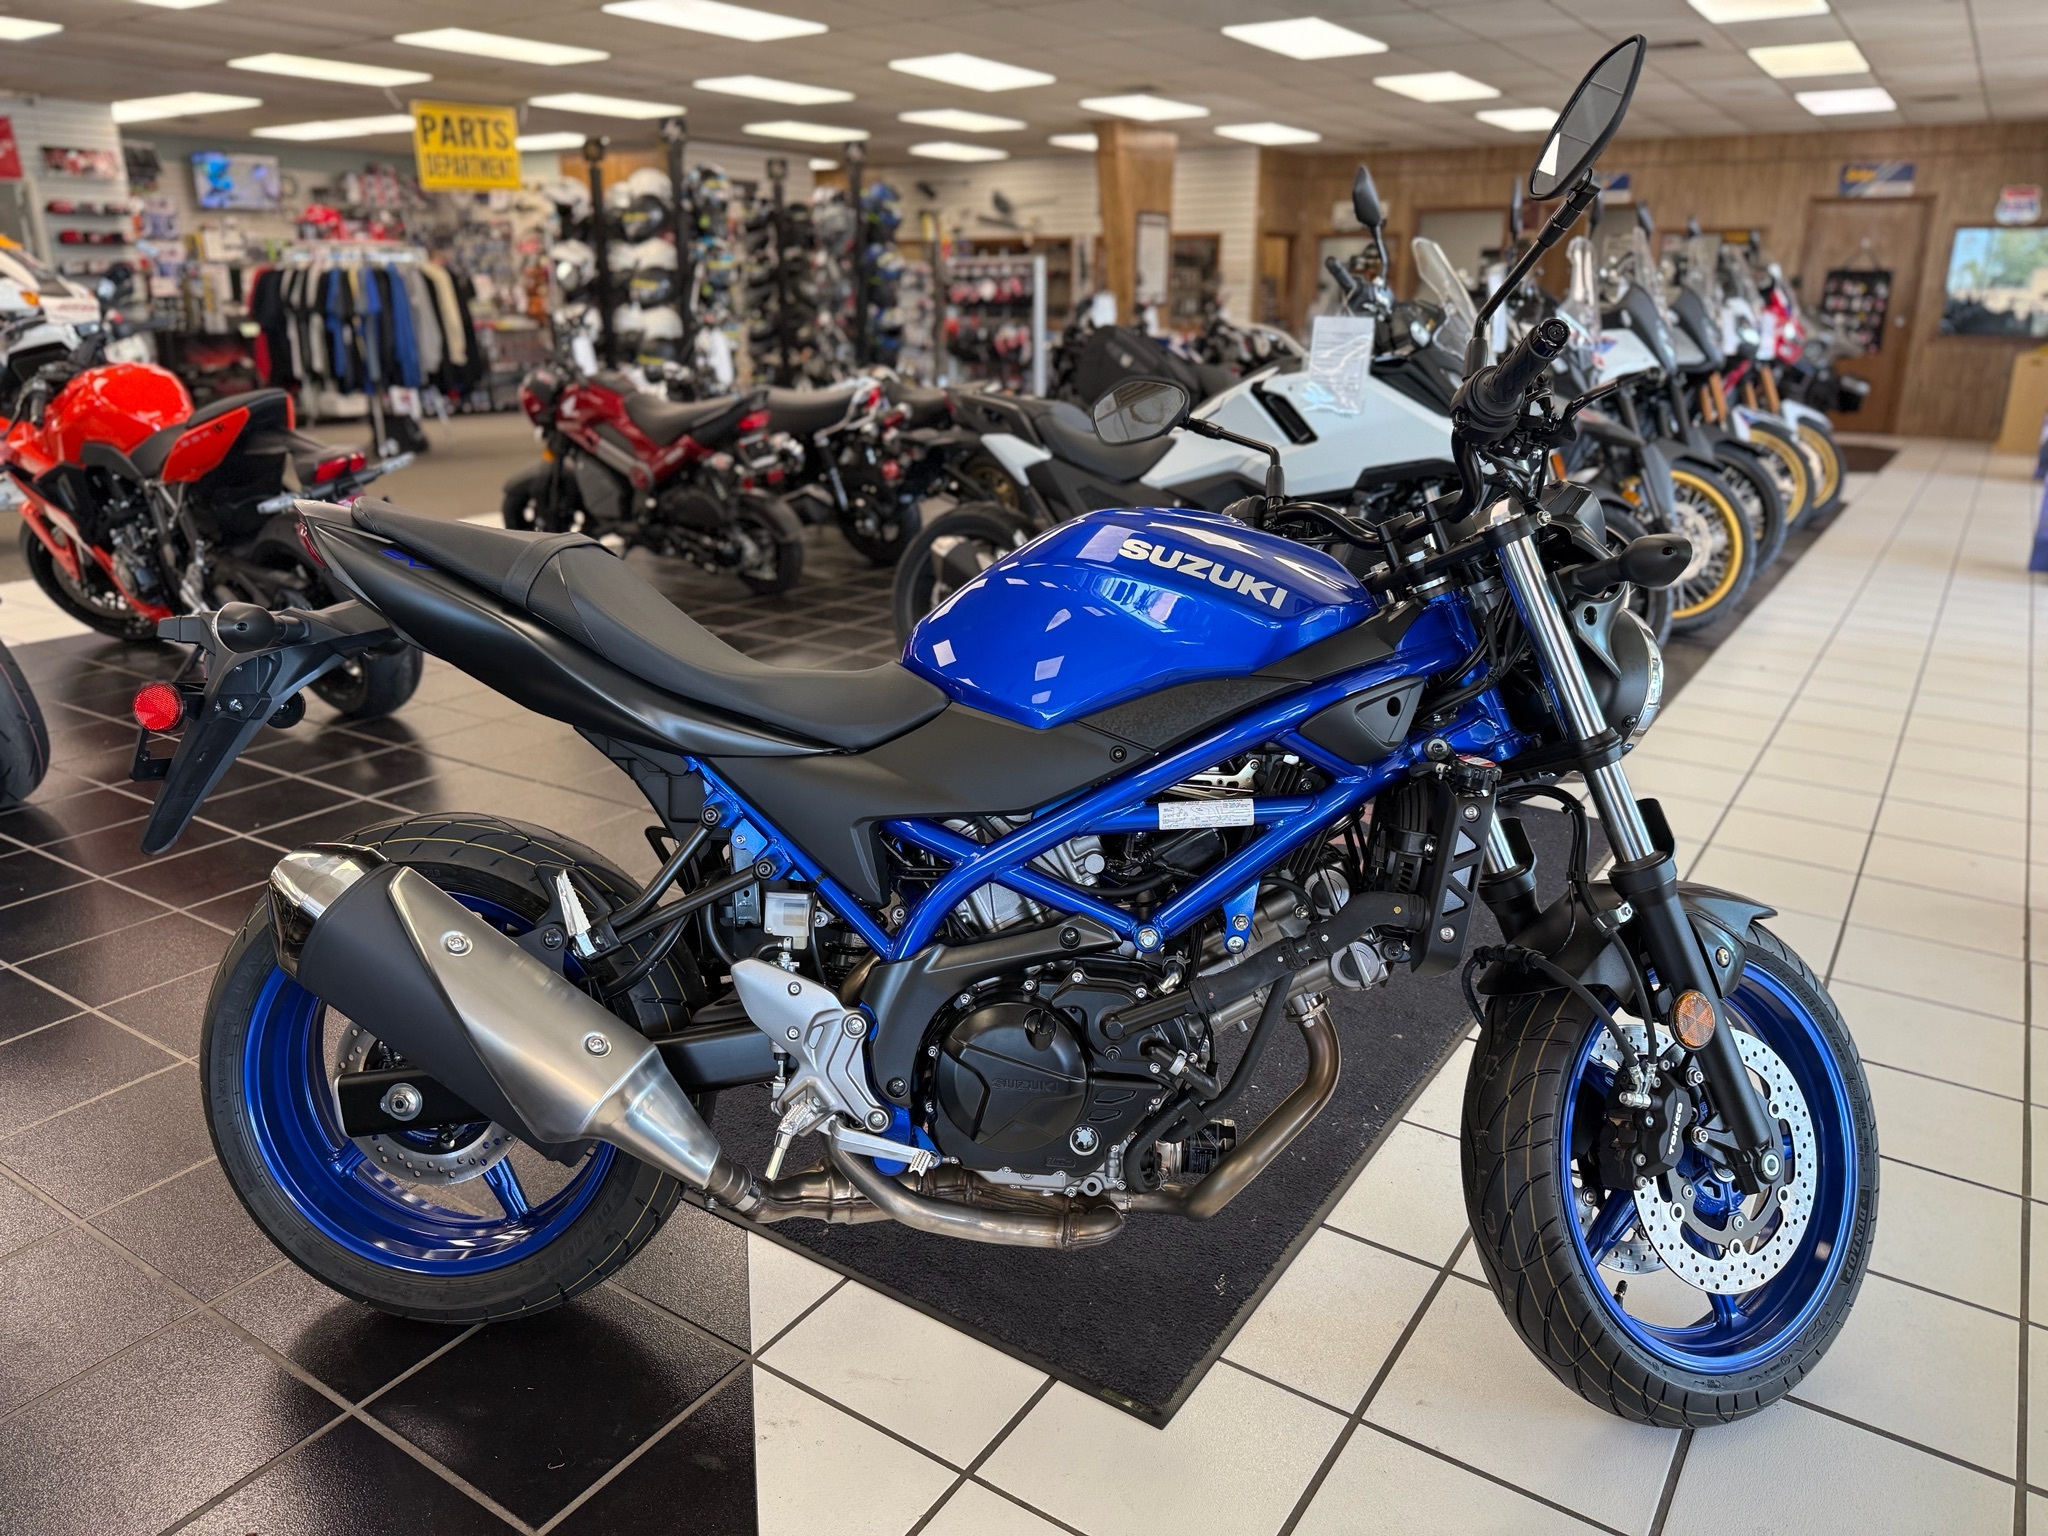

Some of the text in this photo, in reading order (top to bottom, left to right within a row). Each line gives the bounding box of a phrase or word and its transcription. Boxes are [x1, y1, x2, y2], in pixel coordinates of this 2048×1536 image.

[420, 115, 510, 151] PARTS
[1118, 538, 1288, 610] SUZUKI
[991, 1077, 1060, 1093] SUZUKI
[1668, 1102, 1683, 1155] TOKICO
[1845, 1205, 1868, 1277] DUNLOP
